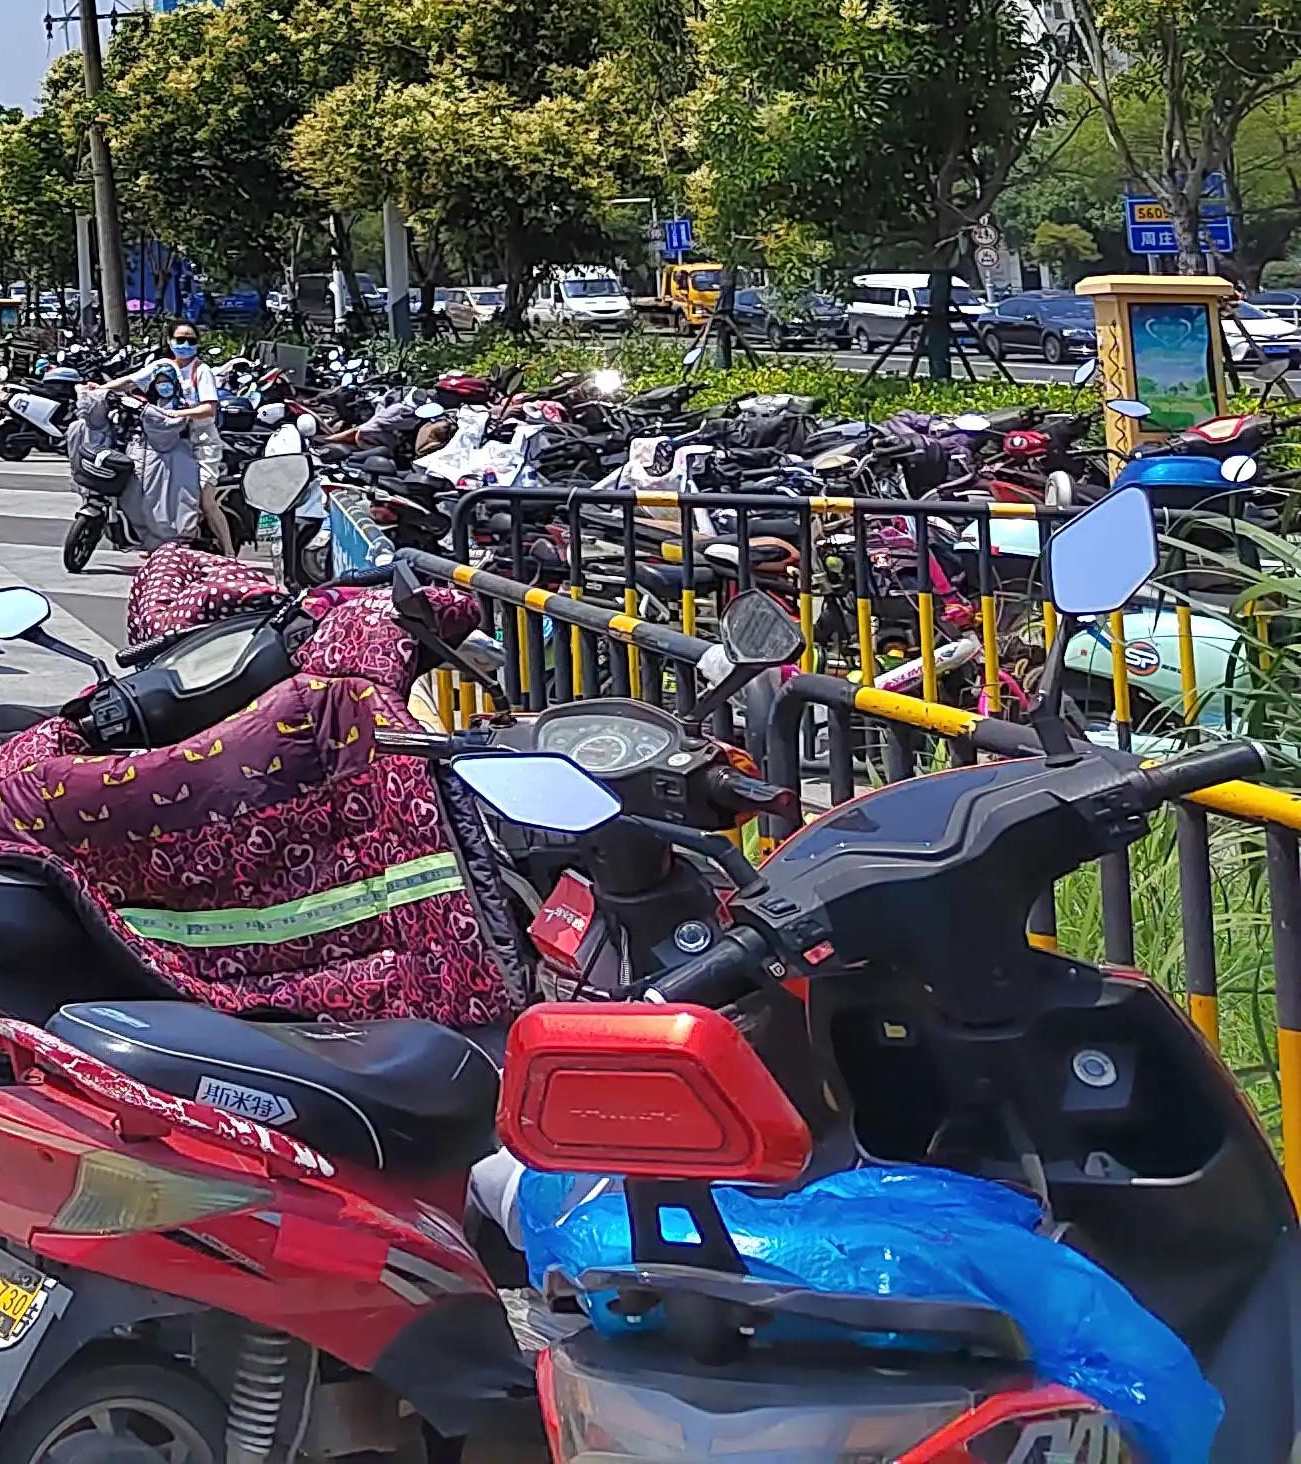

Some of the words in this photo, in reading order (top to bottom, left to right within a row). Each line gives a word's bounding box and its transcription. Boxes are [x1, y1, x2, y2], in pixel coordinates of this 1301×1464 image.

[1138, 207, 1169, 219] S60
[1140, 231, 1175, 247] 周庄
[1125, 647, 1159, 669] SP
[201, 1082, 275, 1118] 斯米特
